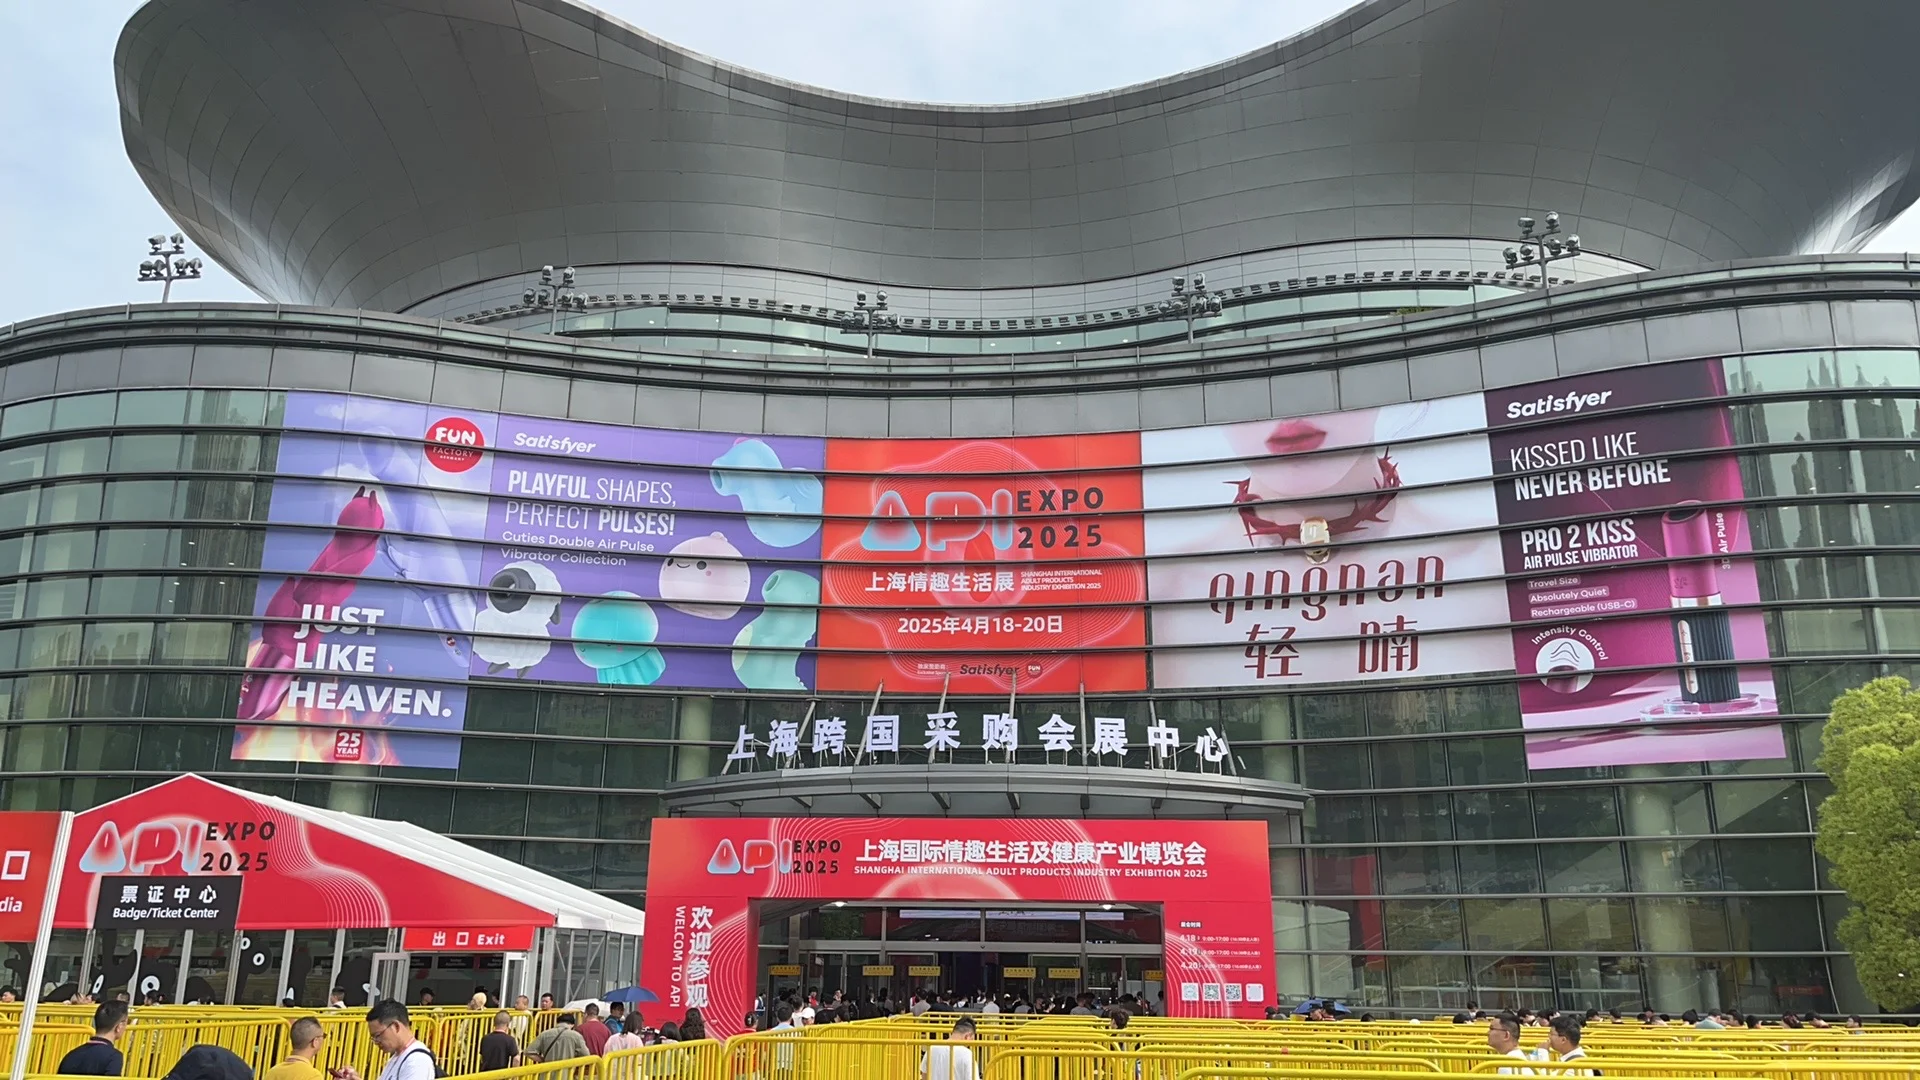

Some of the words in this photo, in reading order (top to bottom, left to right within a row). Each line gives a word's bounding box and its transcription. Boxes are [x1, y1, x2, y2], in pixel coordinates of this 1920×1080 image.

[1506, 390, 1612, 419] Satisfyer
[435, 427, 476, 445] FUN
[513, 432, 596, 454] Satisfyer
[432, 446, 474, 457] FACTORY
[1510, 439, 1586, 472] KISSED
[1592, 431, 1639, 460] LIKE
[508, 469, 590, 499] PLAYFUL
[596, 477, 677, 507] SHAPES,
[1514, 470, 1583, 501] NEVER
[1587, 459, 1671, 491] BEFORE
[1016, 486, 1104, 512] EXPO
[505, 501, 593, 531] PERFECT
[598, 509, 676, 536] PULSES!
[860, 488, 1013, 551] API
[1714, 512, 1726, 538] Pulse
[502, 531, 545, 545] Cuties
[549, 534, 594, 549] Double
[598, 538, 617, 550] Air
[619, 540, 654, 552] Pulse
[1018, 524, 1102, 549] 2025
[1521, 527, 1563, 554] PRO
[1567, 524, 1582, 549] 2
[1586, 517, 1636, 546] KISS
[1719, 538, 1729, 554] Air
[500, 547, 557, 562] Vibrator
[560, 552, 627, 566] Collection
[1524, 555, 1543, 570] AIR
[1545, 551, 1579, 568] PULSE
[1582, 544, 1639, 563] VIBRATOR
[865, 571, 1014, 593] 上海情趣生活展
[1528, 578, 1557, 589] Travel
[1559, 576, 1578, 586] Size
[1530, 590, 1579, 603] Absolutely
[1580, 587, 1607, 598] Quiet
[1531, 603, 1595, 618] Rechargeable
[1597, 599, 1636, 613] (USB-C)
[293, 603, 384, 639] JUST
[898, 615, 1063, 635] 2025年4月18-20日
[1531, 625, 1577, 645] Intensity
[1578, 628, 1609, 661] Control
[294, 642, 376, 672] LIKE
[960, 664, 1019, 678] Satisfyer
[287, 680, 452, 718] HEAVEN.
[337, 732, 361, 748] 25
[727, 711, 1229, 763] 上海跨国采购会展中心
[337, 747, 359, 755] YEAR
[206, 821, 276, 841] EXPO
[79, 820, 202, 873] API
[707, 838, 792, 875] API
[793, 839, 842, 853] EXPO
[856, 838, 1207, 866] 上海国际情趣生活及健康产业博览会
[201, 852, 269, 872] 2025
[792, 860, 839, 874] 2025
[854, 866, 904, 875] SHANGHAI
[907, 866, 984, 876] INTERNATIONAL
[986, 867, 1017, 876] ADULT
[1020, 868, 1071, 876] PRODUCTS
[1073, 868, 1121, 877] INDUSTRY
[1125, 868, 1181, 877] EXHIBITION
[1184, 869, 1208, 878] 2025
[120, 884, 217, 904] 票证中心
[113, 907, 182, 921] Badge/Ticket
[183, 907, 220, 919] Center
[432, 931, 469, 946] 出口
[477, 933, 505, 946] Exit
[673, 905, 686, 961] WELCOM
[685, 906, 713, 1008] 欢迎参观
[671, 965, 682, 982] TO
[670, 985, 681, 1007] API
